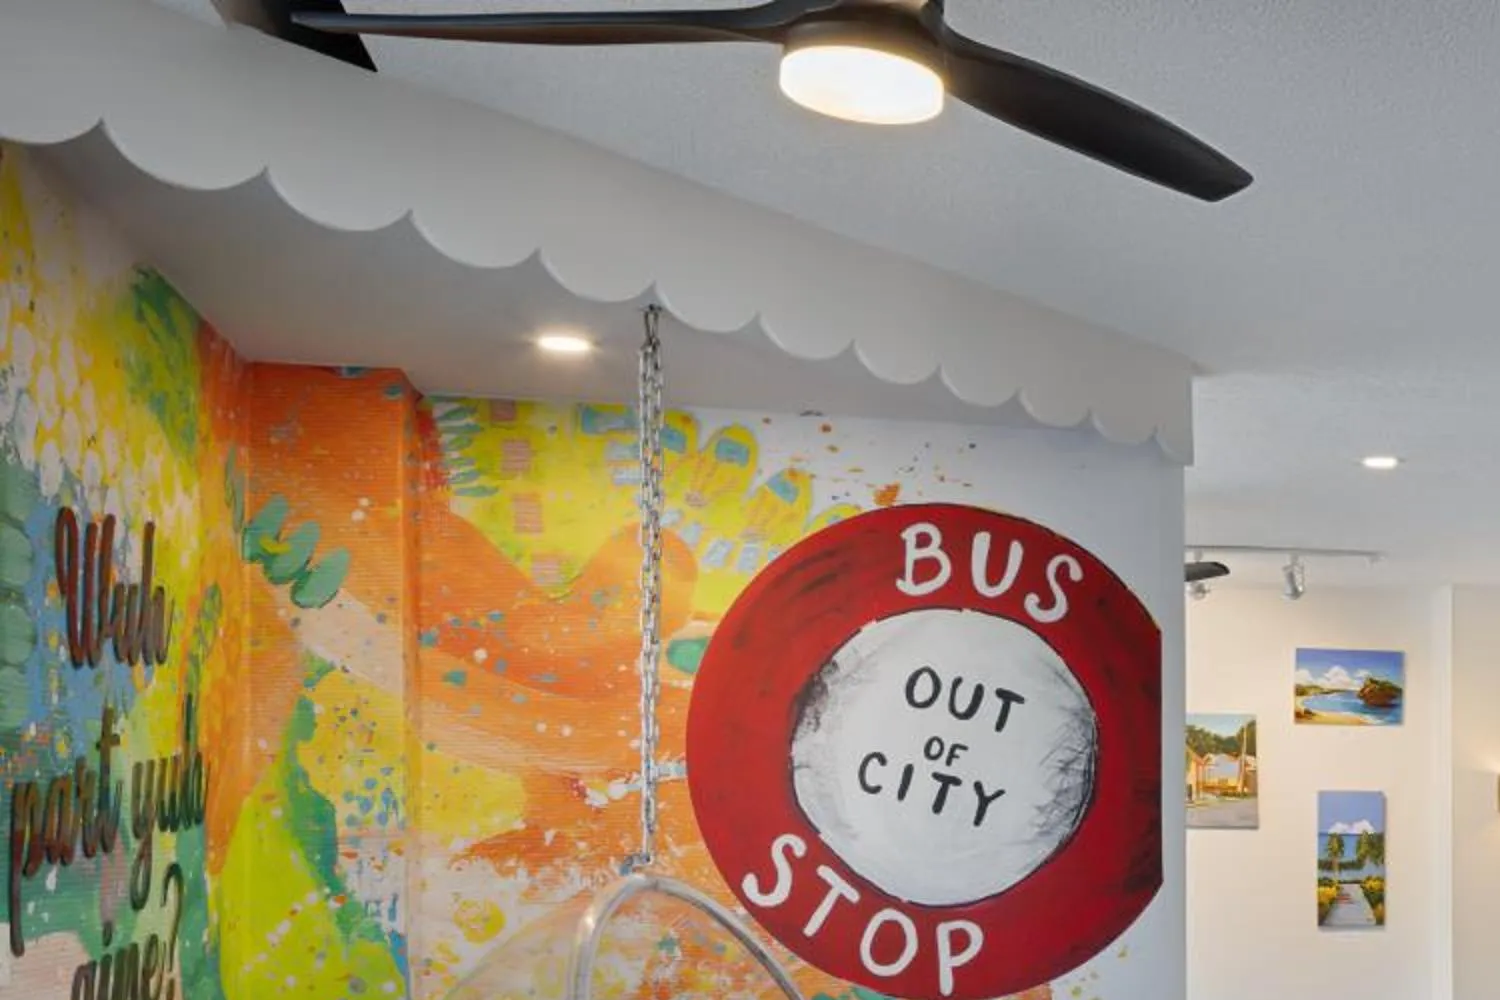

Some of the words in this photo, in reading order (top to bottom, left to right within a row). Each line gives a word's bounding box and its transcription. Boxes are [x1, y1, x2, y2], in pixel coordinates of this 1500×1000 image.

[896, 521, 1083, 624] BUS
[904, 666, 1026, 733] OUT
[857, 750, 1006, 827] CITY
[923, 735, 969, 767] OF
[742, 833, 985, 998] STOP
